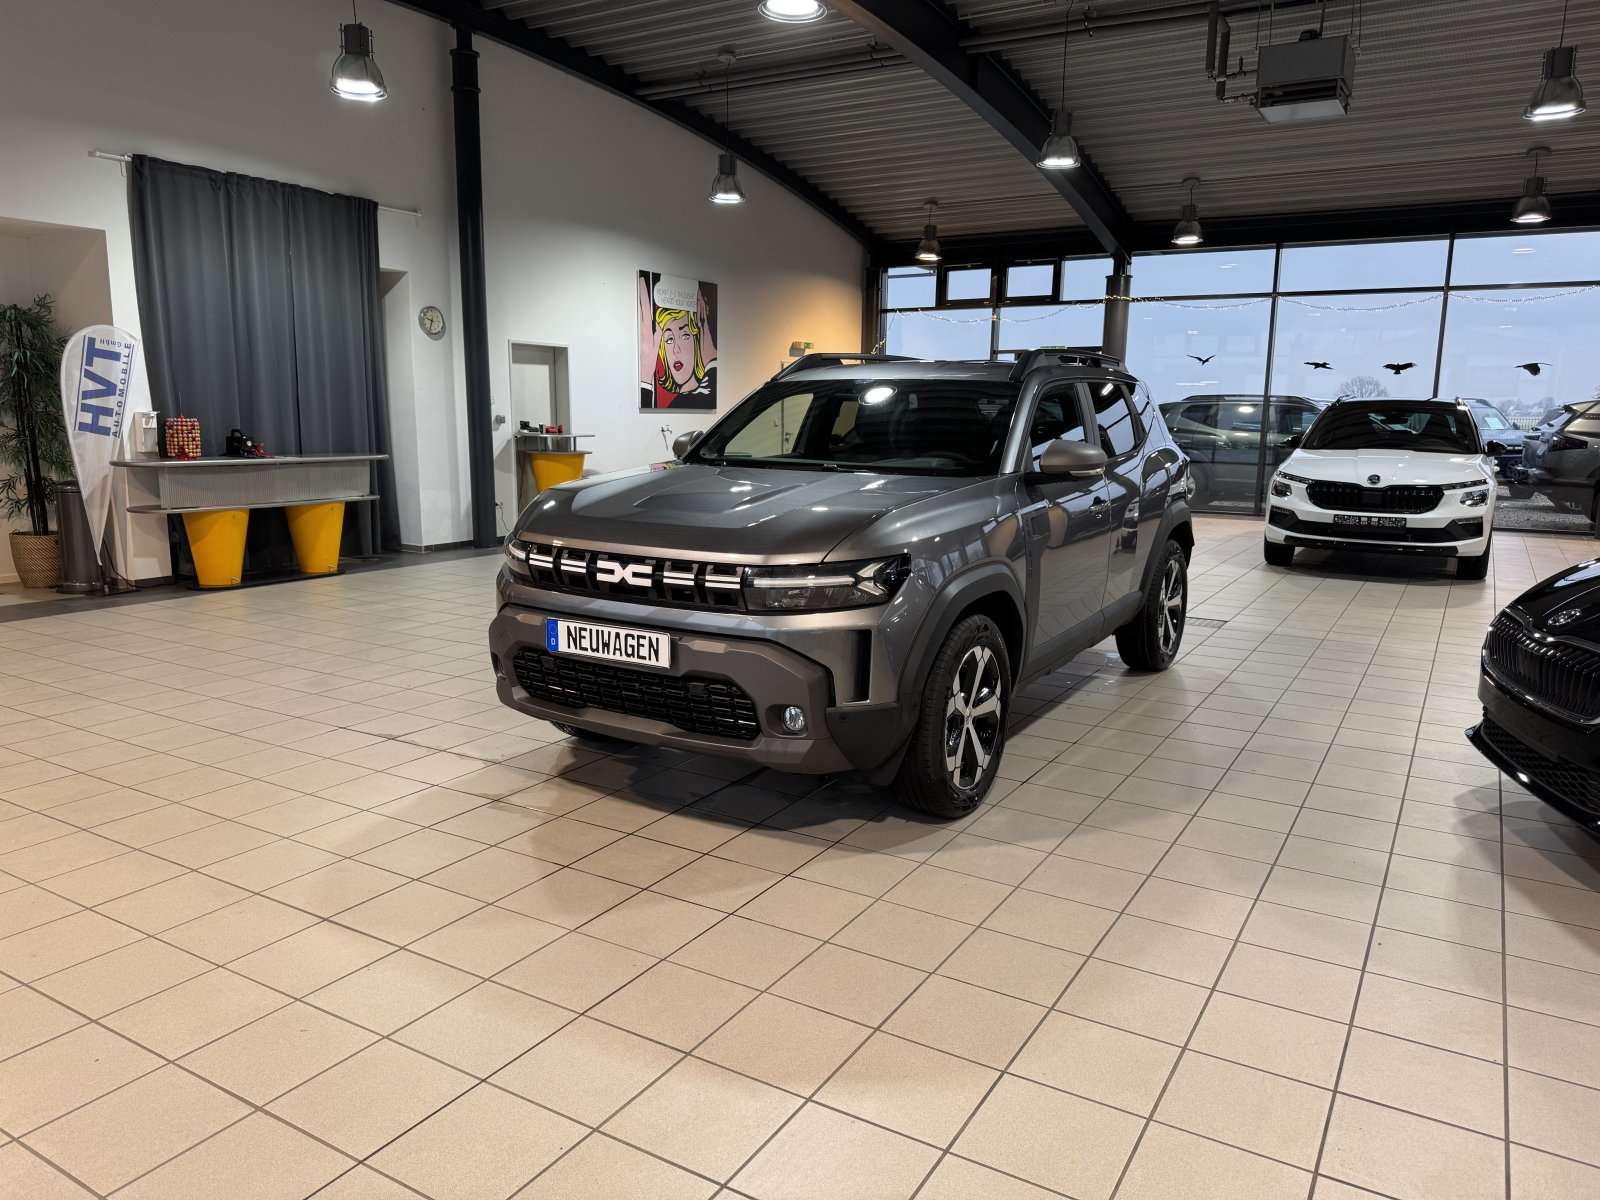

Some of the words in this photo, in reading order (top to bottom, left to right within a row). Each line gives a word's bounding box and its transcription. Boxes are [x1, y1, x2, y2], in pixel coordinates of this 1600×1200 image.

[78, 336, 122, 436] HVT
[111, 343, 132, 438] AUTOMOBILE
[566, 625, 660, 662] NEUWAGEN
